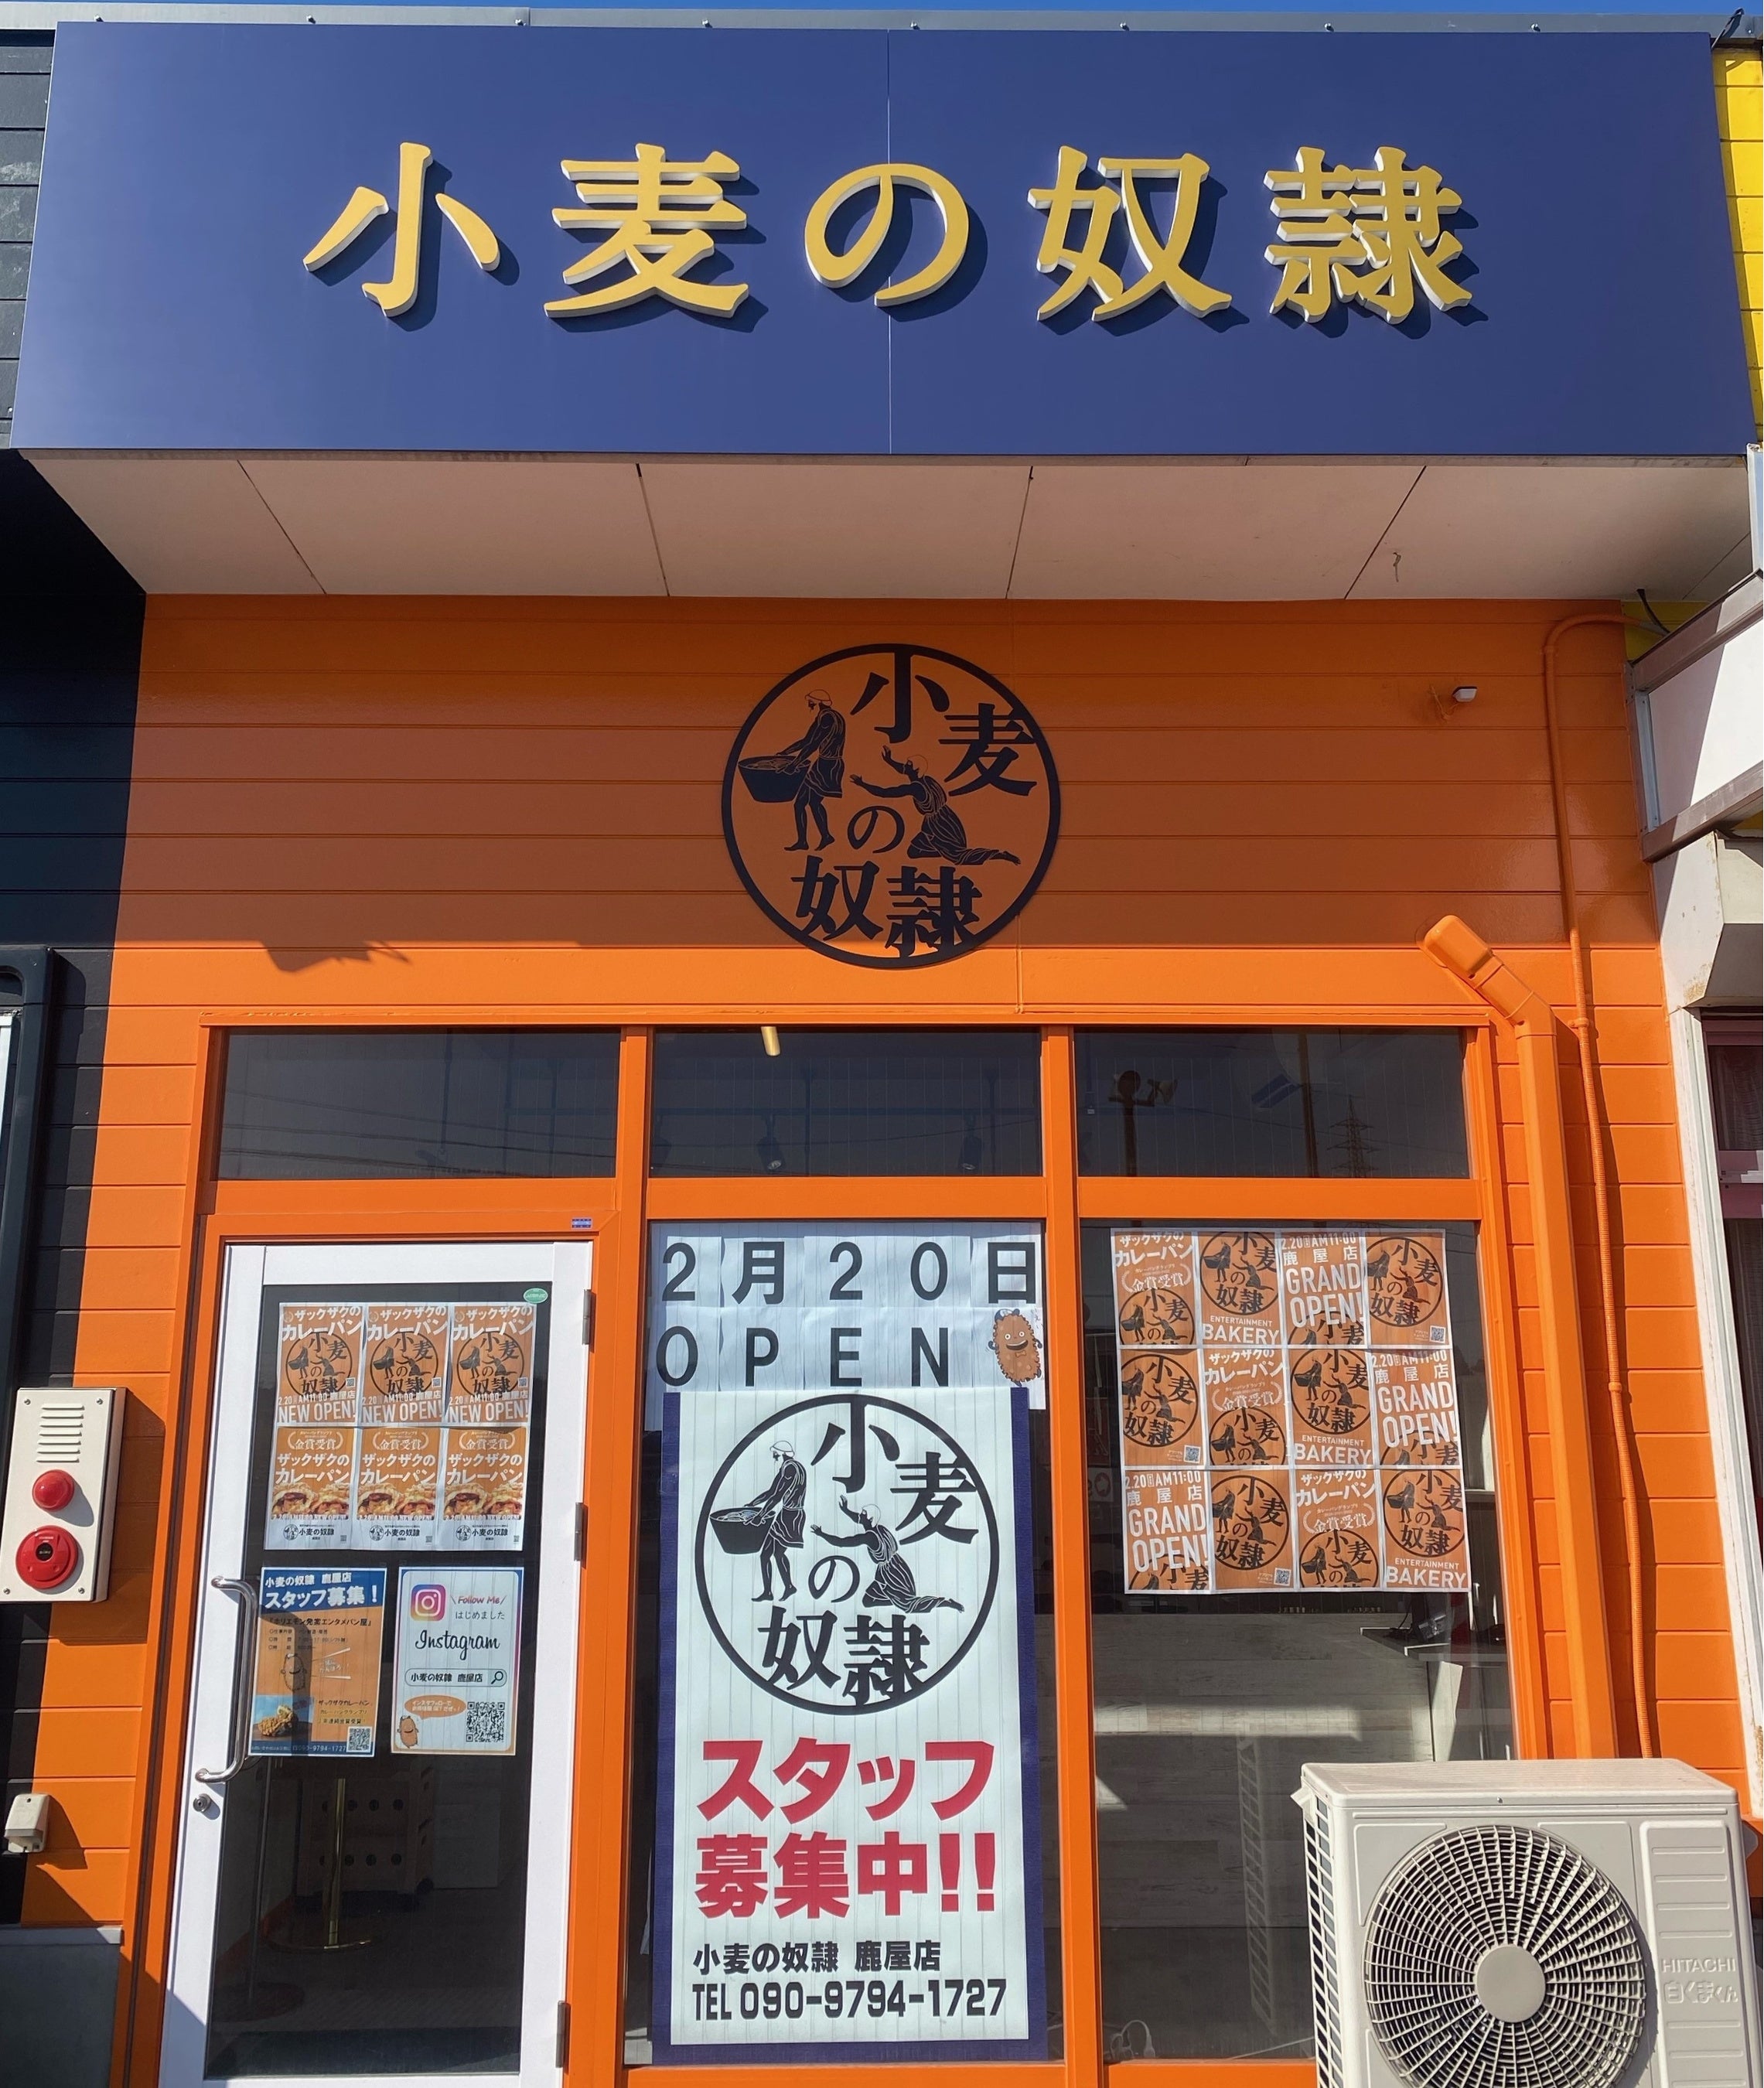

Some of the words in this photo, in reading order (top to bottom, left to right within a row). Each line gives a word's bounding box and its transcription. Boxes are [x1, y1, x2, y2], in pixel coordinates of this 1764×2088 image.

[302, 142, 1465, 323] 小麦の奴隷
[1120, 1232, 1184, 1247] ザックザクの
[1114, 1244, 1193, 1267] カレーパン
[1285, 1264, 1361, 1294] GRAND
[295, 1305, 360, 1322] ザックザクの
[380, 1305, 446, 1322] ザックザクの
[466, 1305, 533, 1322] ザックザクの
[1210, 1315, 1273, 1326] ENTERTAINMENT
[1290, 1292, 1364, 1328] OPEN!
[282, 1319, 362, 1341] カレーパン
[367, 1319, 448, 1341] カレーパン
[452, 1319, 534, 1341] カレーパン
[1203, 1324, 1279, 1345] BAKERY
[656, 1325, 949, 1387] OPEN
[1209, 1349, 1274, 1365] ザックザクの
[1205, 1361, 1283, 1385] カレーパン
[1378, 1381, 1454, 1414] GRAND
[278, 1404, 309, 1423] NEW
[363, 1404, 395, 1423] NEW
[449, 1404, 481, 1423] NEW
[1383, 1411, 1458, 1448] OPEN!
[1302, 1435, 1364, 1446] ENTERTAINMENT
[277, 1452, 350, 1467] ザックザクの
[363, 1453, 435, 1467] ザックザクの
[449, 1453, 522, 1467] ザックザクの
[1295, 1443, 1371, 1465] BAKERY
[275, 1468, 350, 1485] カレーパン
[360, 1469, 435, 1485] カレーパン
[447, 1469, 522, 1485] カレーパン
[1301, 1471, 1367, 1486] ザックザクの
[1296, 1482, 1376, 1506] カレーパン
[1128, 1503, 1206, 1537] GRAND
[1132, 1534, 1209, 1572] OPEN!
[1395, 1558, 1459, 1569] ENTERTAINMENT
[1387, 1566, 1466, 1588] BAKERY
[458, 1595, 484, 1604] Follow
[456, 1611, 505, 1620] はじめました
[415, 1629, 500, 1660] Instagram
[697, 1737, 995, 1825] スタッフ
[693, 1942, 838, 1974] 小麦の奴隷
[855, 1940, 941, 1972] 鹿屋店
[1662, 1958, 1736, 1972] HITACHI
[692, 1982, 732, 2020] TEL
[740, 1979, 1007, 2019] 090-9794-1727
[1664, 1981, 1738, 2004] 白くまくん
